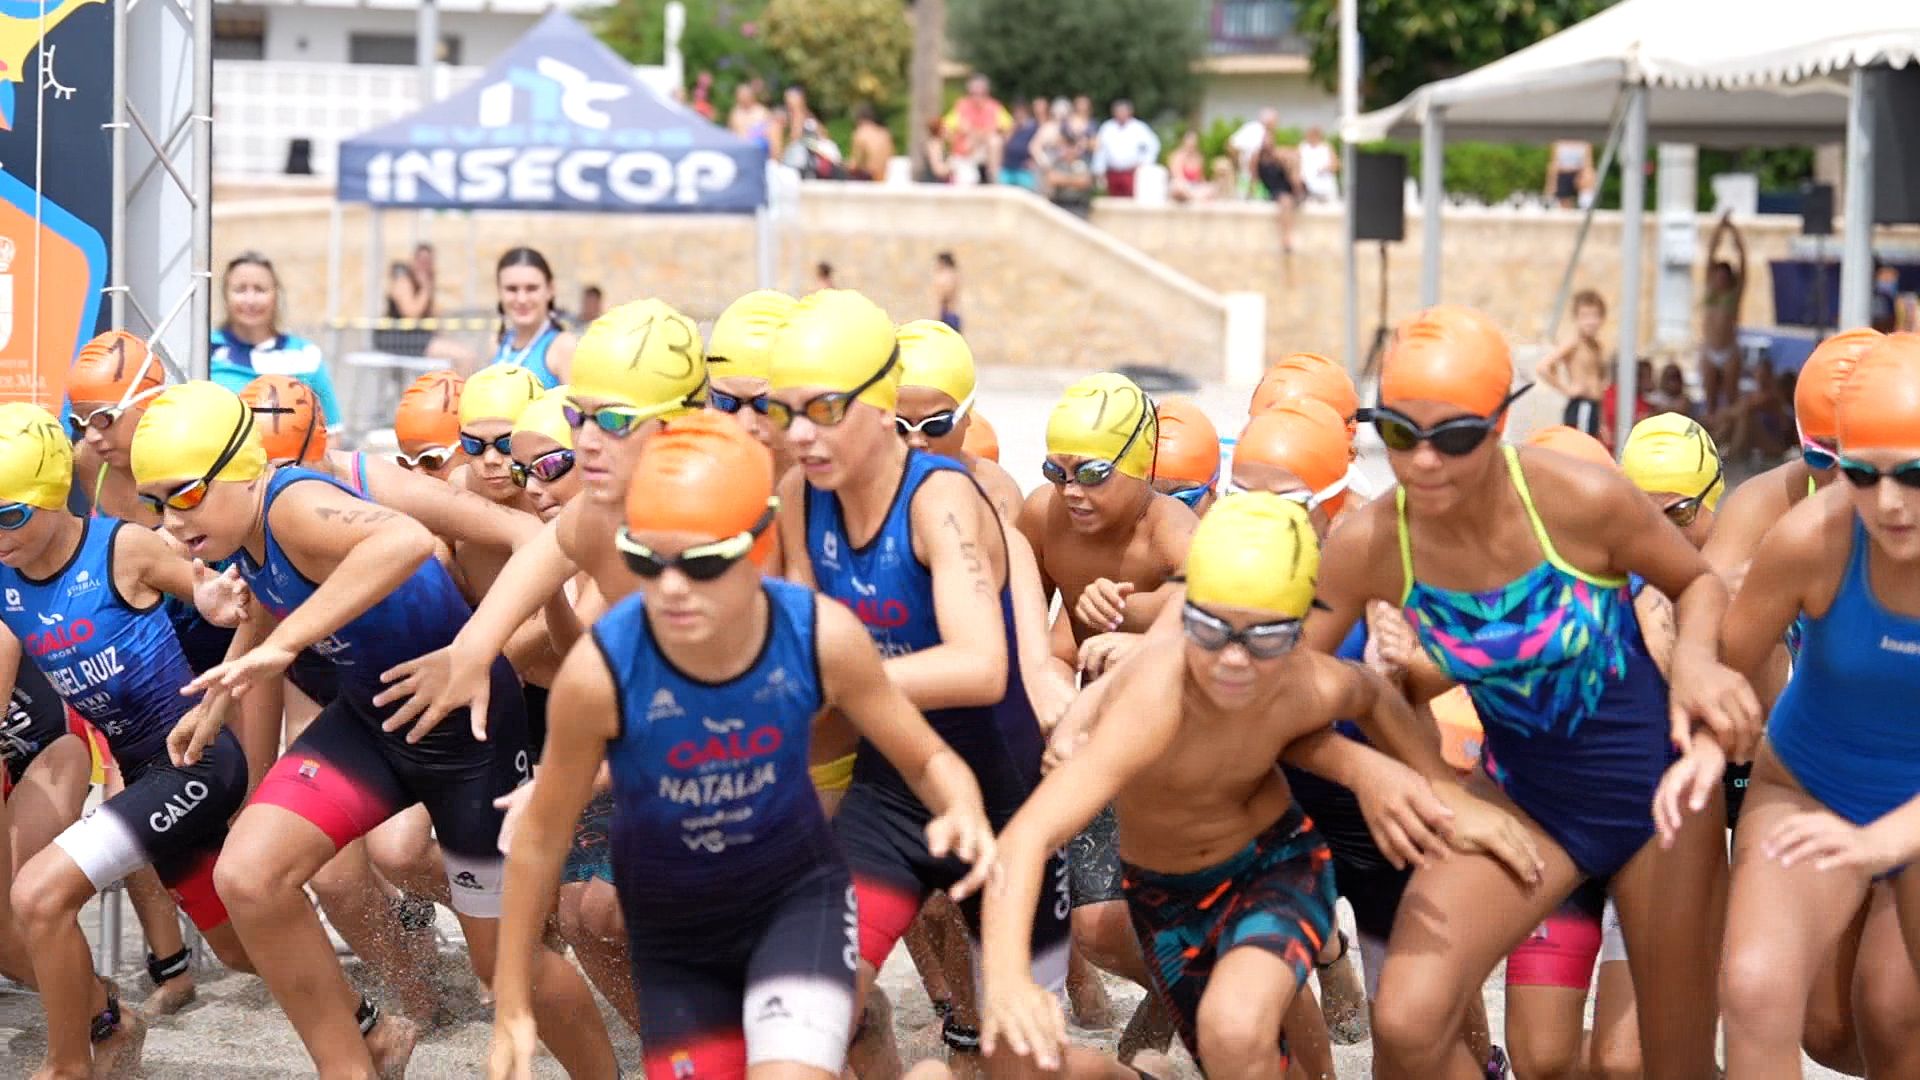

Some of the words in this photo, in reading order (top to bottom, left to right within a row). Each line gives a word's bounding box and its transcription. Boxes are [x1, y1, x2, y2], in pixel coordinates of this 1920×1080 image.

[366, 148, 738, 204] INSECOP
[627, 315, 693, 380] 13
[26, 618, 95, 657] GALO
[79, 645, 125, 687] RUIZ
[666, 725, 784, 771] GALO
[149, 780, 209, 833] GALO
[659, 760, 777, 807] NATALIA
